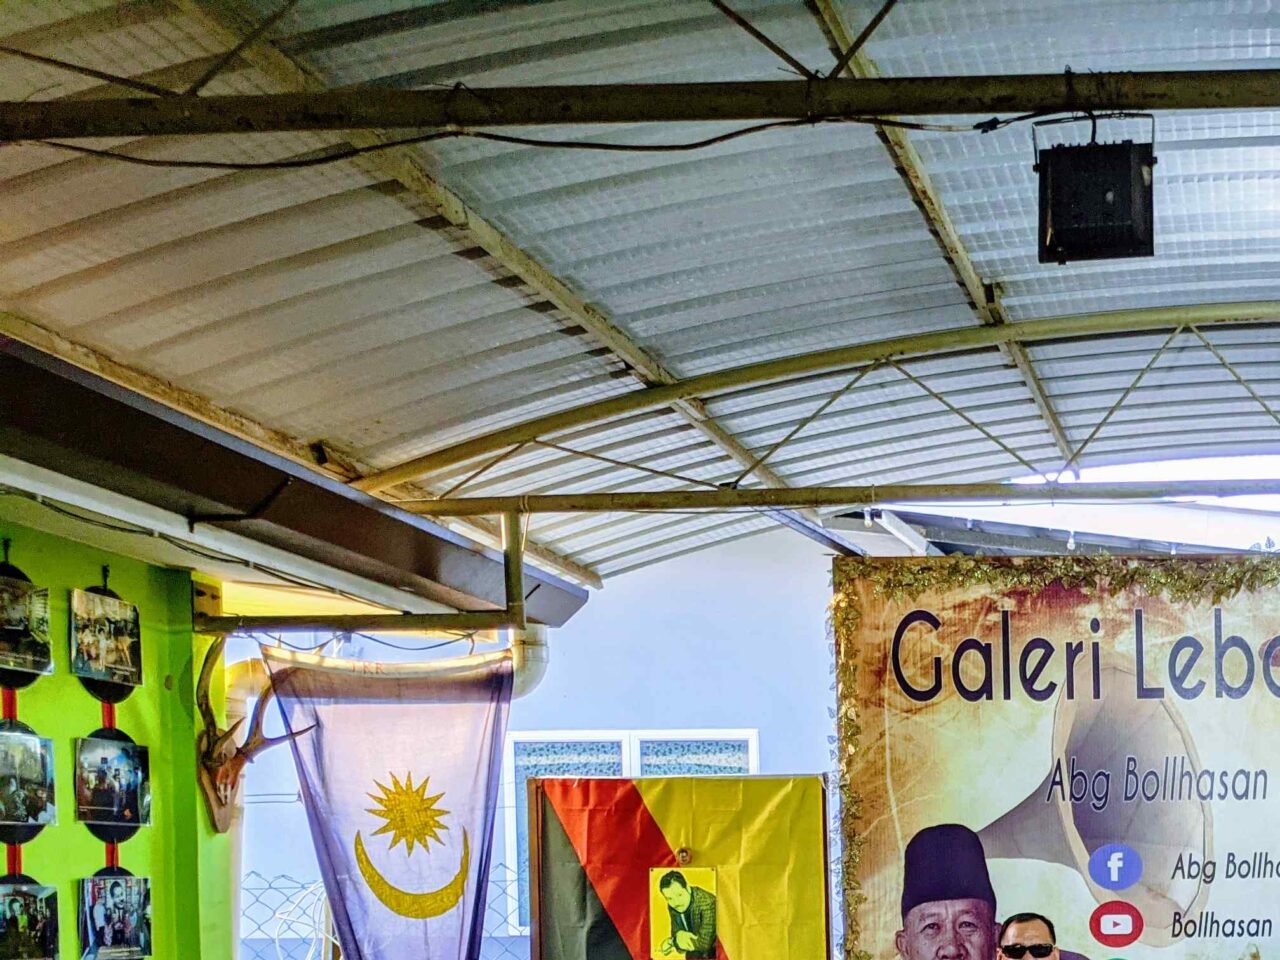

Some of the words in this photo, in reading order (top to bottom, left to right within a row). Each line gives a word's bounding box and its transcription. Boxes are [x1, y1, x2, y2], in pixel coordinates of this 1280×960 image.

[891, 608, 1101, 702] Galeri
[1046, 756, 1111, 812] Abg
[1123, 755, 1268, 802] Bollhasan
[1171, 852, 1217, 885] Abg
[1171, 911, 1273, 938] Bollhasan
